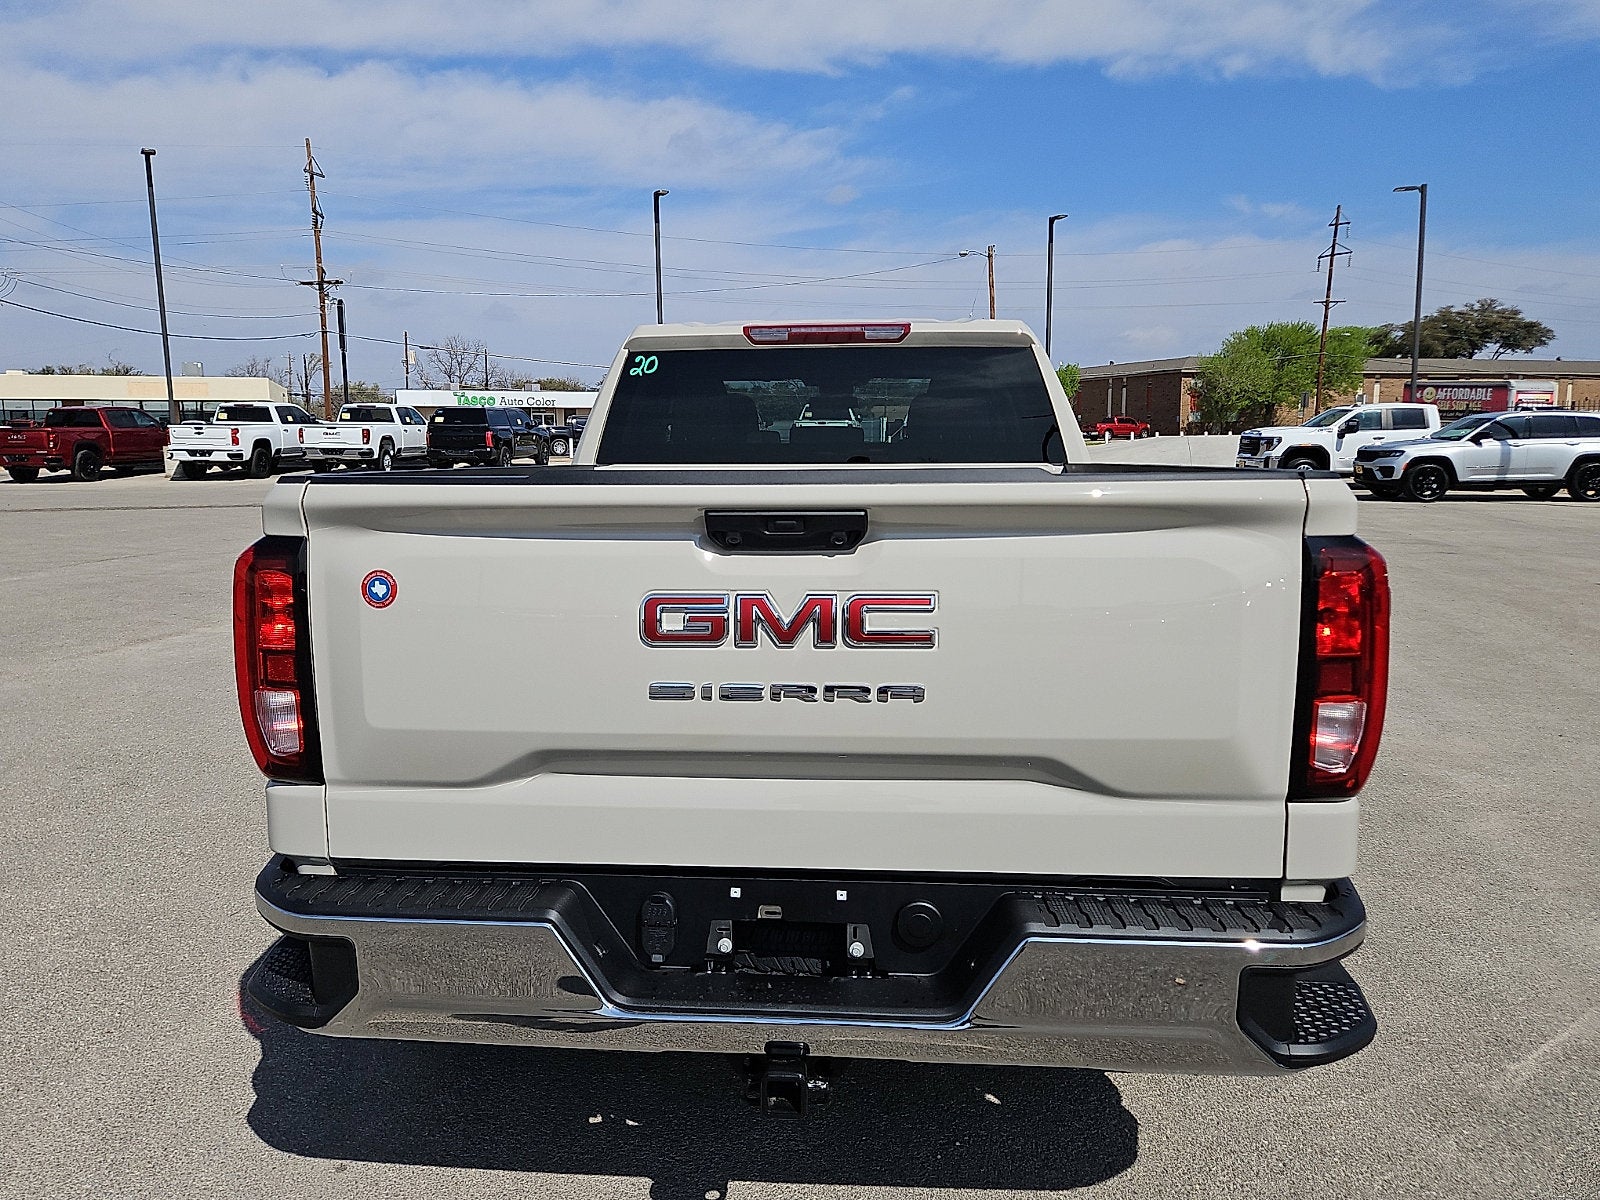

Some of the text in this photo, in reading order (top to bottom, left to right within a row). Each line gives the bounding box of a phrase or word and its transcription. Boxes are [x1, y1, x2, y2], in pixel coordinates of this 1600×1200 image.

[629, 355, 659, 377] 20
[453, 391, 556, 406] TASCO Auto Color
[1435, 387, 1493, 400] AFFORDABLE
[1437, 400, 1452, 411] SELF
[638, 589, 939, 650] GMC
[648, 681, 926, 704] SIERRA
